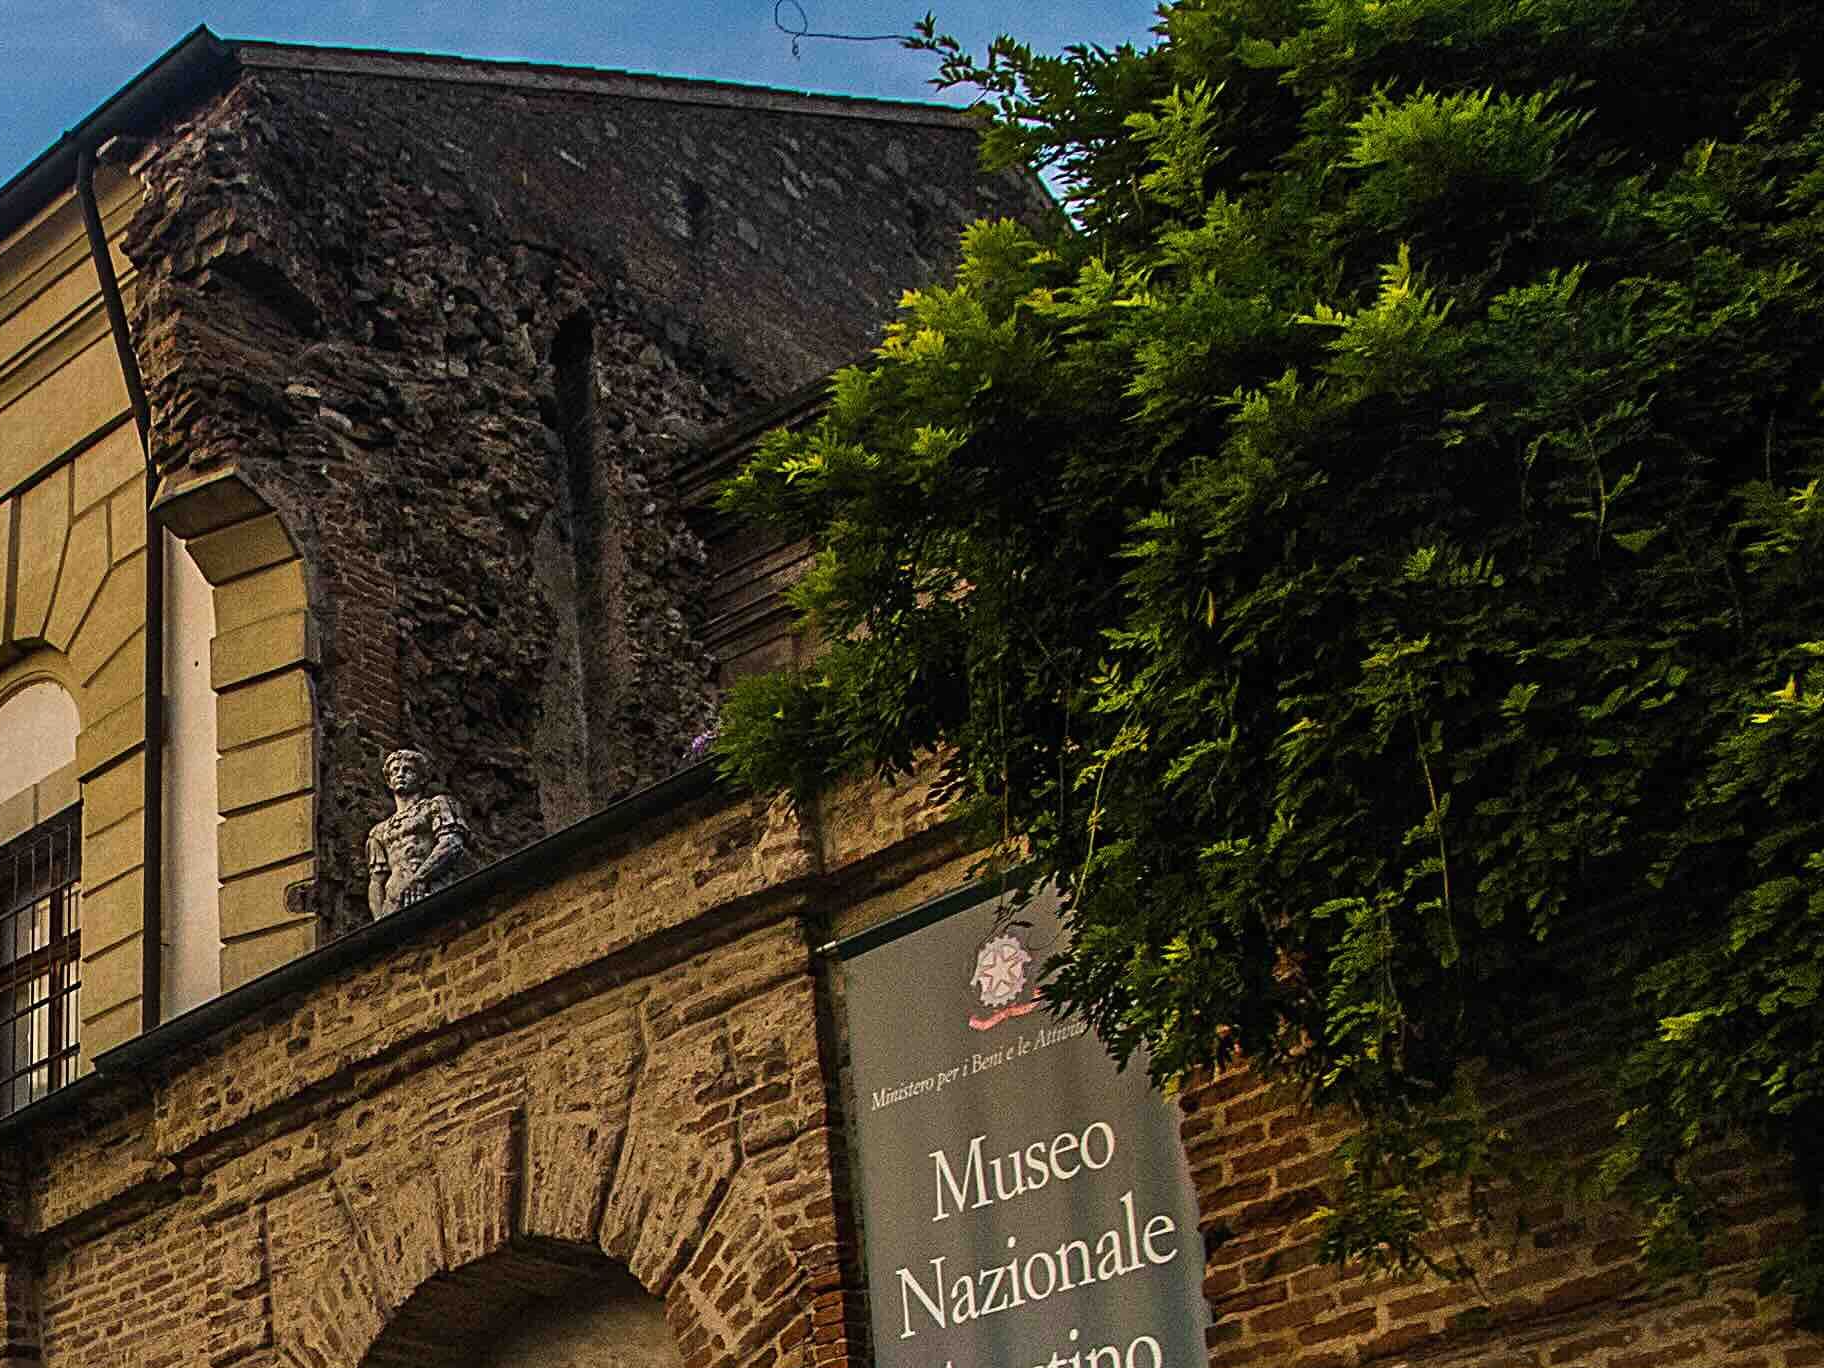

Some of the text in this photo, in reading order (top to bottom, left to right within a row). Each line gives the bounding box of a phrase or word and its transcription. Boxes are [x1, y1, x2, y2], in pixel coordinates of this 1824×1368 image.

[871, 1076, 935, 1112] Ministero
[936, 1067, 960, 1092] per
[962, 1058, 969, 1077] i
[970, 1045, 1004, 1074] Beni
[1006, 1046, 1015, 1061] e
[1018, 1035, 1032, 1057] le
[928, 1120, 1116, 1223] Museo
[895, 1191, 1178, 1340] Nazionale
